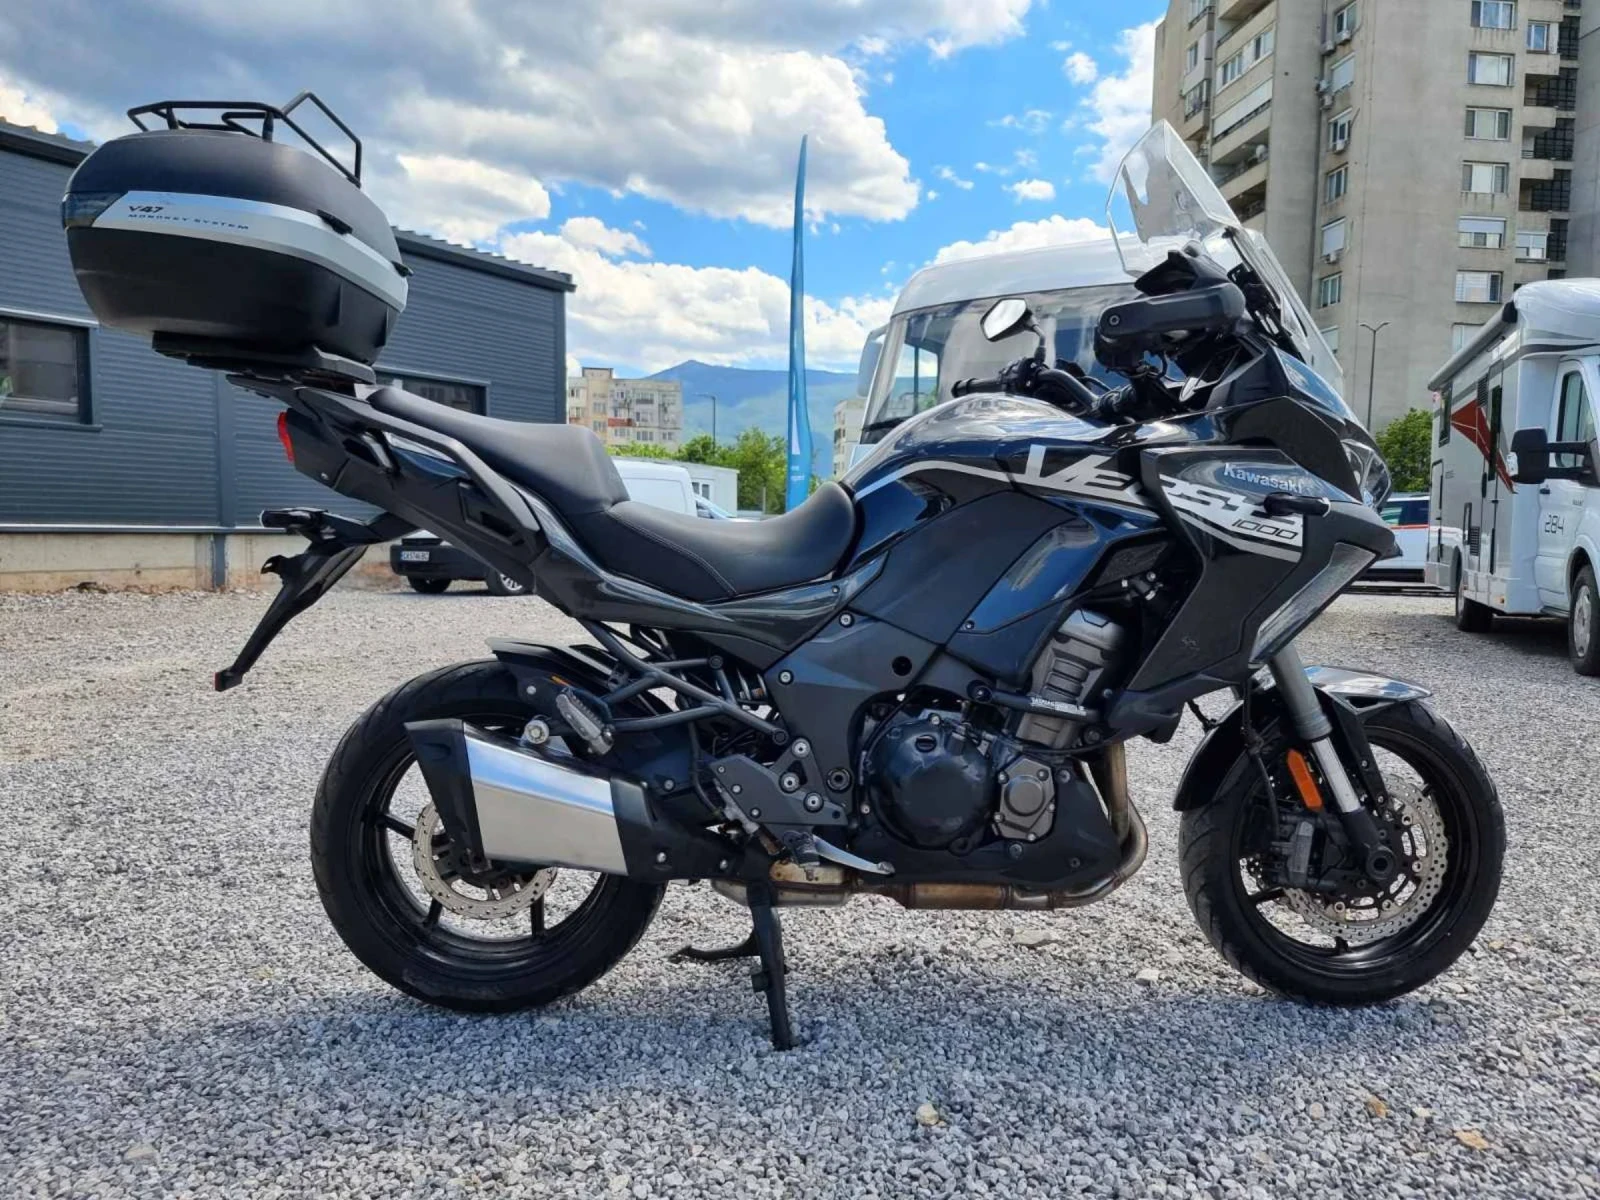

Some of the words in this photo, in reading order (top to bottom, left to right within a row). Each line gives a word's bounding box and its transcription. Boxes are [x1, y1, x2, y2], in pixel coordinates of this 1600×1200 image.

[128, 205, 164, 213] V47
[193, 218, 249, 230] SYSTEM
[1223, 462, 1304, 495] Kawasaki
[1231, 518, 1299, 540] 1000
[1544, 513, 1565, 536] 284
